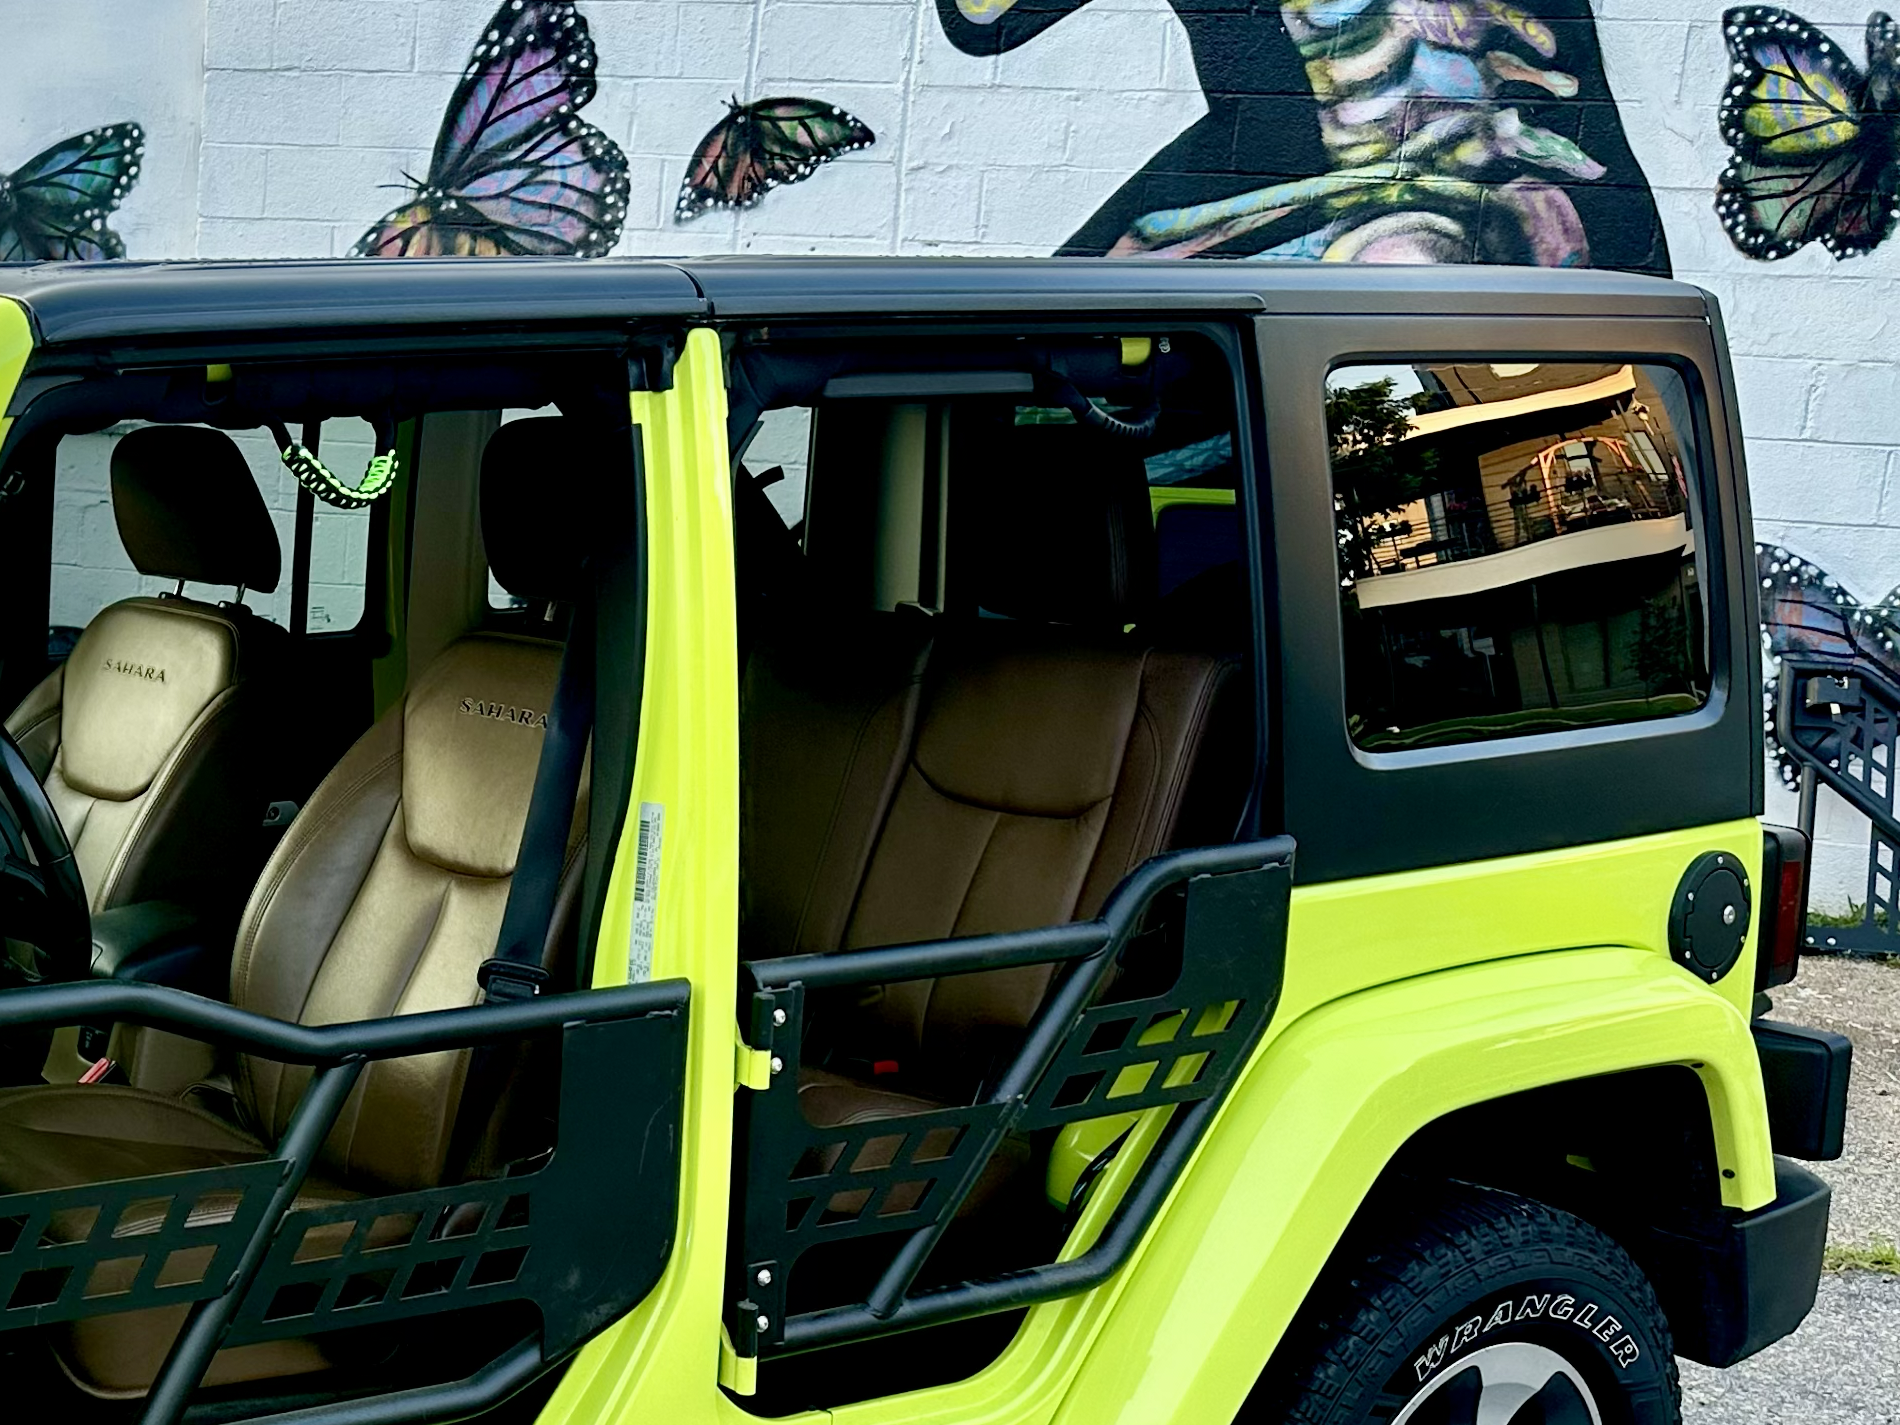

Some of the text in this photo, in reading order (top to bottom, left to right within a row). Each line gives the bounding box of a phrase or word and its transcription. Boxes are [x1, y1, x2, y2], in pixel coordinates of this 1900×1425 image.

[102, 658, 167, 683] SAHARA
[460, 697, 548, 730] SAHARA
[1413, 1293, 1640, 1382] WRANGLER
